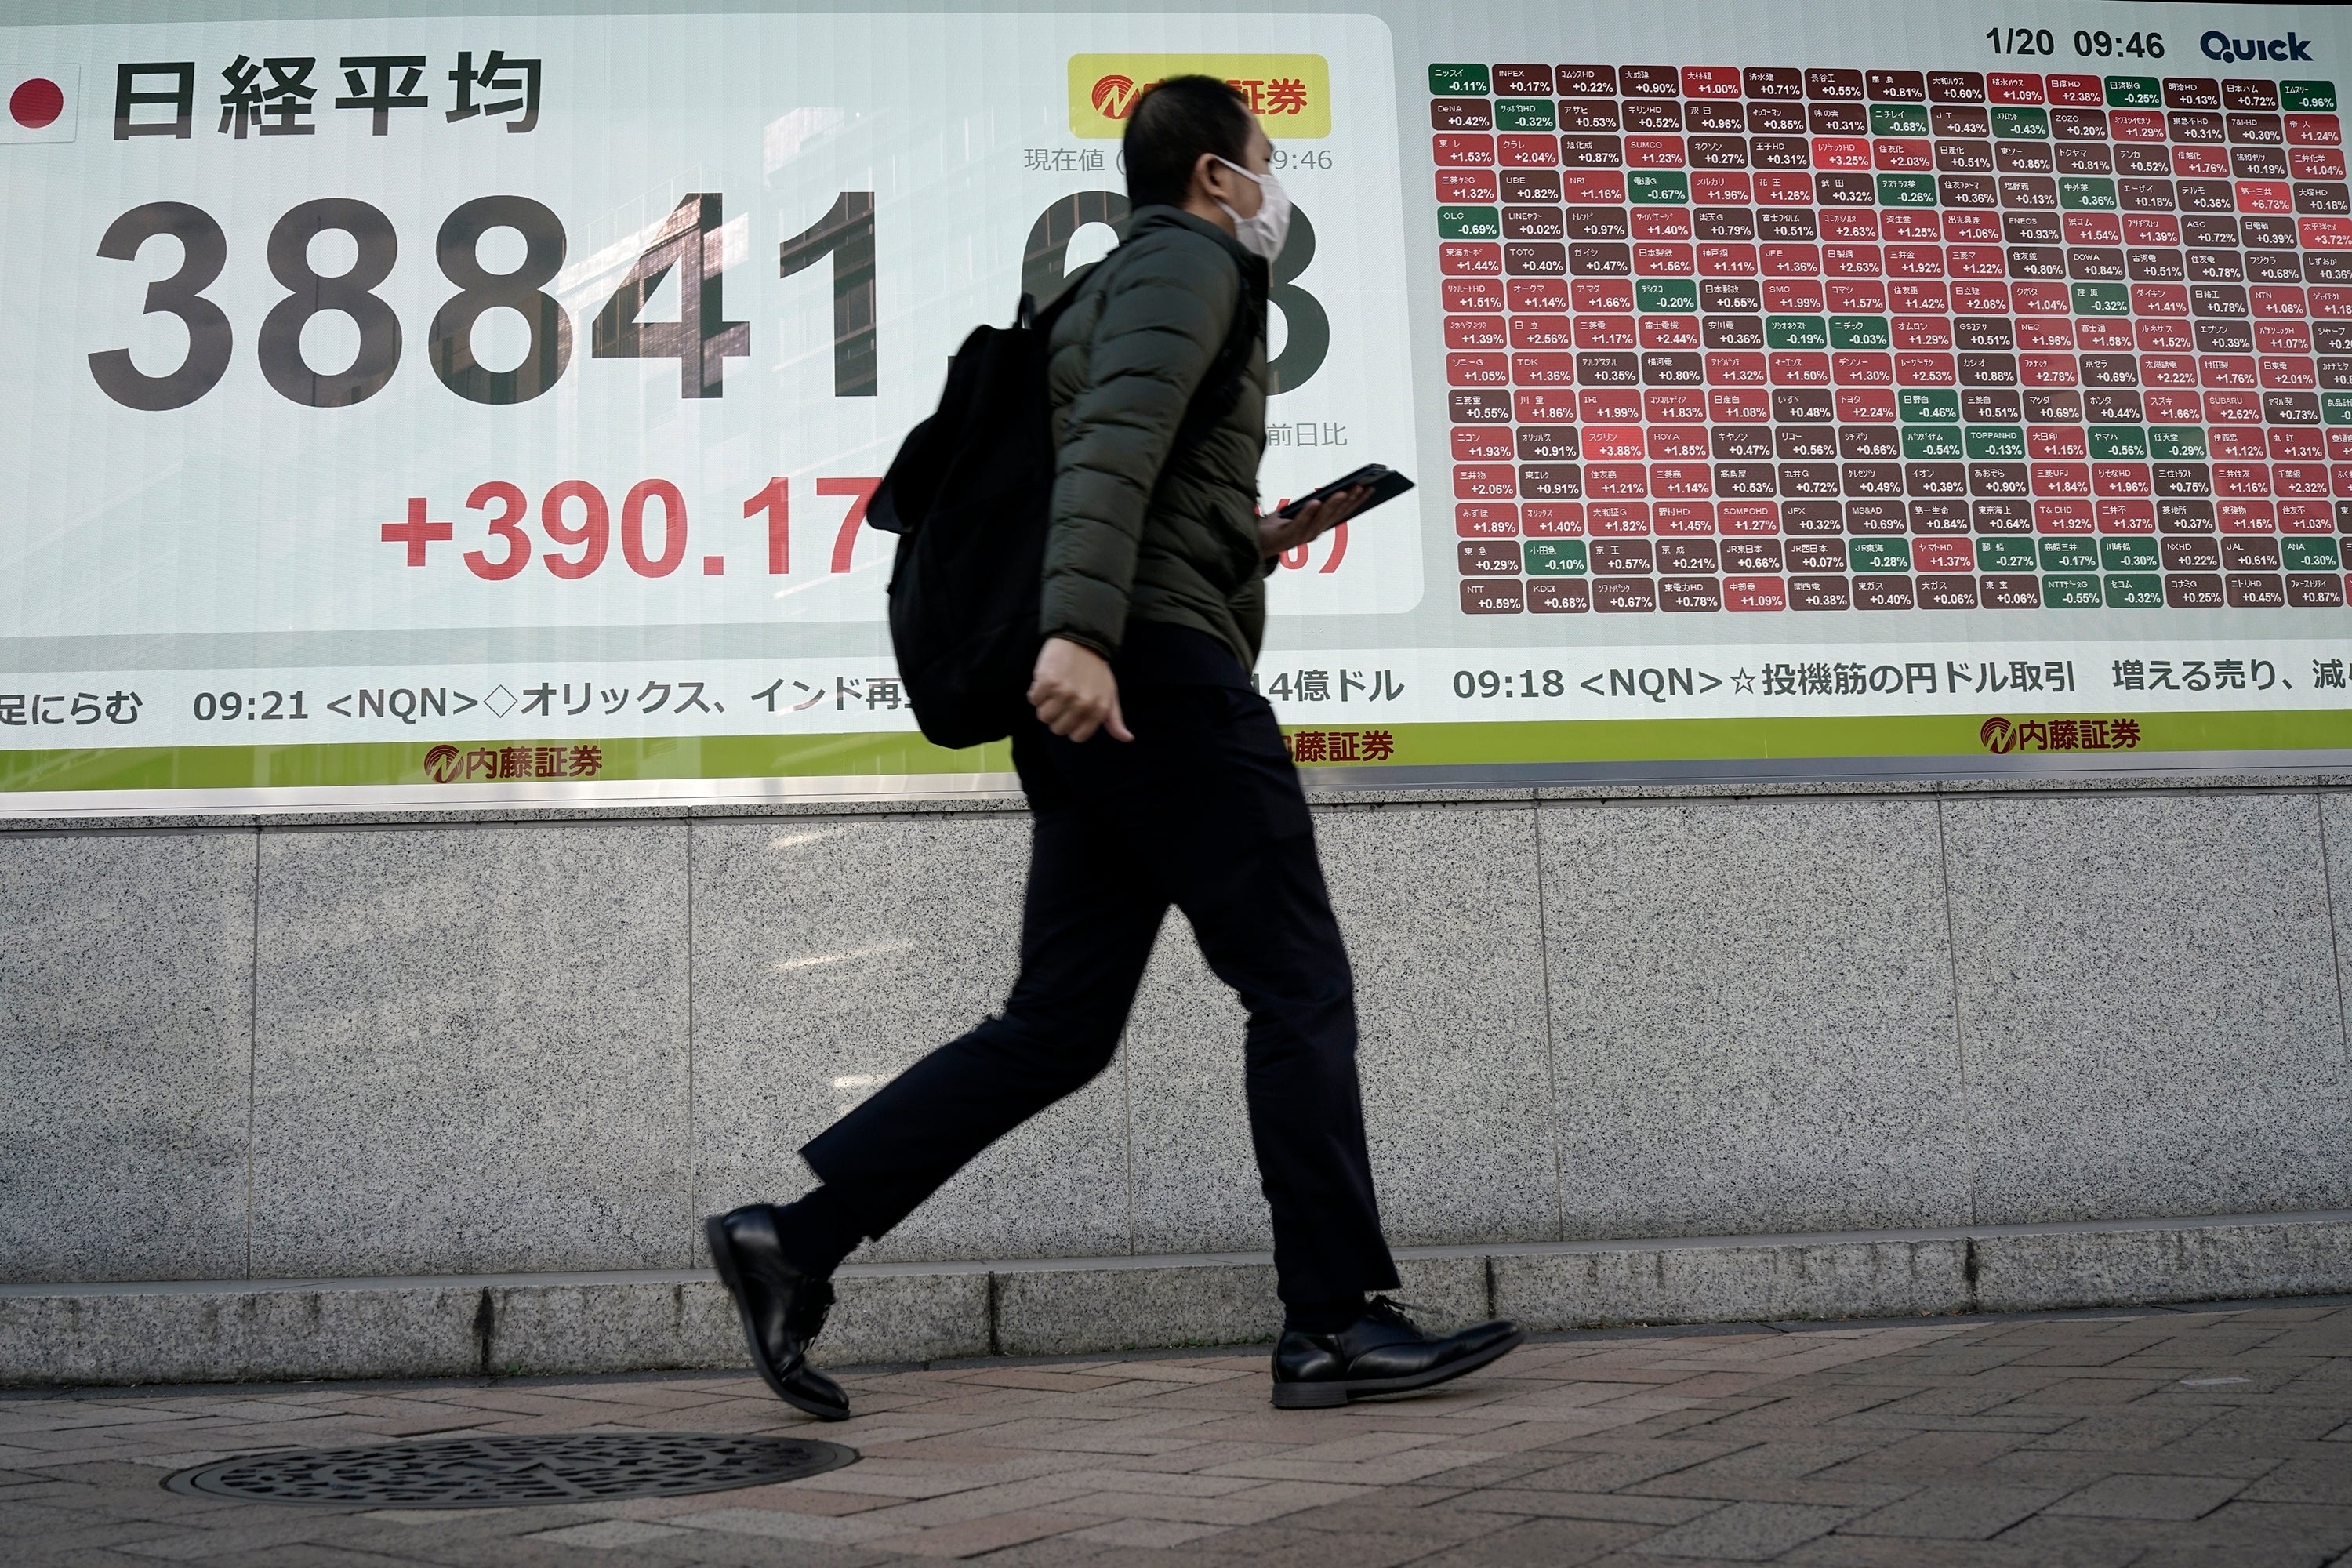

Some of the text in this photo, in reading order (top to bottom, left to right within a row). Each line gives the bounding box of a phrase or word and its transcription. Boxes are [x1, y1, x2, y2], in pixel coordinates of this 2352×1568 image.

[1986, 27, 2165, 59] 1/20 09:46
[1434, 68, 1464, 78] ニッスイ
[1449, 81, 1487, 91] -0.11%
[1509, 82, 1551, 92] +0.17%
[2168, 82, 2198, 92] 明治HD
[2227, 84, 2259, 93] 日本ハム
[113, 50, 543, 140] 日経平均
[2180, 95, 2218, 105] +0.13%
[2238, 96, 2276, 107] +0.72%
[1875, 110, 1904, 119] ニチレイ
[1448, 116, 1490, 126] +0.42%
[1889, 122, 1926, 132] -0.68%
[2067, 125, 2106, 136] +0.20%
[2242, 130, 2281, 140] +0.30%
[1503, 140, 1525, 149] クラレ
[1755, 142, 1785, 151] 王子HD
[1514, 152, 1556, 162] +2.04%
[1641, 153, 1682, 164] +1.23%
[2060, 148, 2087, 158] トクヤマ
[2294, 154, 2325, 163] 三井化学
[1024, 148, 1105, 172] 現在値
[1273, 150, 1333, 170] 9:46
[1766, 154, 1808, 165] +0.31%
[2071, 160, 2110, 171] +0.81%
[2305, 165, 2343, 176] +1.04%
[1697, 177, 1725, 187] メルカリ
[1517, 188, 1559, 199] +0.82%
[1581, 189, 1622, 199] +1.16%
[1708, 190, 1748, 200] +1.96%
[2241, 187, 2273, 196] 第一三共
[2251, 199, 2290, 209] +6.73%
[2068, 217, 2092, 227] 浜ゴム
[1457, 224, 1497, 234] -0.69%
[2020, 229, 2060, 240] +0.93%
[2079, 230, 2119, 241] +1.54%
[2198, 232, 2237, 243] +0.72%
[1639, 248, 1674, 257] 日本製鉄
[1522, 260, 1564, 271] +0.40%
[1650, 261, 1692, 271] +1.56%
[2249, 256, 2277, 265] フジクラ
[1777, 261, 1818, 272] +1.36%
[2084, 265, 2123, 276] +0.84%
[2261, 268, 2299, 279] +0.68%
[1513, 284, 1544, 293] オークマ
[1831, 285, 1853, 294] コマツ
[88, 191, 1330, 411] 38841
[1524, 297, 1566, 307] +1.14%
[1780, 297, 1821, 308] +1.99%
[1842, 298, 1883, 309] +1.57%
[2265, 303, 2304, 314] +1.06%
[1897, 321, 1928, 331] オムロン
[1908, 334, 1949, 345] +1.29%
[2031, 336, 2071, 346] +1.96%
[2092, 336, 2132, 347] +1.58%
[1452, 358, 1483, 367] ソニーG
[2085, 359, 2108, 368] 京セラ
[1464, 371, 1507, 381] +1.05%
[1529, 370, 1571, 381] +1.36%
[2096, 372, 2136, 383] +0.69%
[2274, 374, 2314, 384] +2.01%
[1714, 395, 1740, 405] 日産自
[1841, 395, 1861, 404] トヨタ
[1596, 407, 1639, 418] +1.99%
[1726, 407, 1767, 418] +1.08%
[1853, 407, 1894, 418] +2.24%
[2220, 409, 2259, 419] +2.62%
[1266, 422, 1348, 447] 前日比
[1457, 434, 1481, 442] ニコン
[2154, 432, 2179, 441] 任天堂
[1468, 446, 1512, 457] +1.93%
[1664, 445, 1707, 456] +1.85%
[1984, 445, 2023, 456] -0.13%
[2169, 445, 2205, 456] -0.29%
[1784, 469, 1809, 478] 丸井G
[1911, 469, 1935, 478] イオン
[1974, 468, 2005, 477] あおぞら
[2098, 469, 2131, 478] りそなHD
[2218, 469, 2251, 478] 三井住友
[1796, 481, 1838, 492] +0.72%
[1922, 481, 1964, 492] +0.39%
[1985, 481, 2027, 492] +0.90%
[2109, 481, 2149, 492] +1.96%
[2229, 482, 2268, 492] +1.16%
[1658, 507, 1690, 517] 野村HD
[1977, 506, 2012, 515] 東京海上
[1670, 520, 1712, 531] +1.45%
[1734, 520, 1777, 531] +1.27%
[1799, 519, 1841, 530] +0.32%
[1863, 519, 1904, 530] +0.69%
[1989, 518, 2031, 529] +0.64%
[381, 477, 884, 582] +390.17
[1530, 546, 1557, 555] 小田急
[1726, 544, 1763, 554] JR東日本
[1544, 559, 1584, 570] -0.10%
[1737, 557, 1780, 568] +0.66%
[2178, 555, 2218, 566] +0.22%
[2238, 555, 2278, 566] +0.61%
[2300, 555, 2336, 566] -0.30%
[1857, 581, 1884, 590] 東ガス
[2110, 579, 2133, 589] セコム
[2230, 579, 2262, 588] ニトリHD
[1478, 597, 1521, 609] +0.59%
[1544, 597, 1588, 608] +0.68%
[1870, 594, 1911, 605] +0.40%
[2124, 592, 2161, 603] -0.32%
[2242, 592, 2281, 603] +0.45%
[193, 691, 309, 721] 09:21
[1453, 669, 1565, 699] 09:18
[2112, 659, 2352, 691] 増える売り、減
[2018, 717, 2141, 750] 内藤証券
[1283, 729, 1394, 762] 藤証券
[466, 745, 603, 779] 内藤証券
